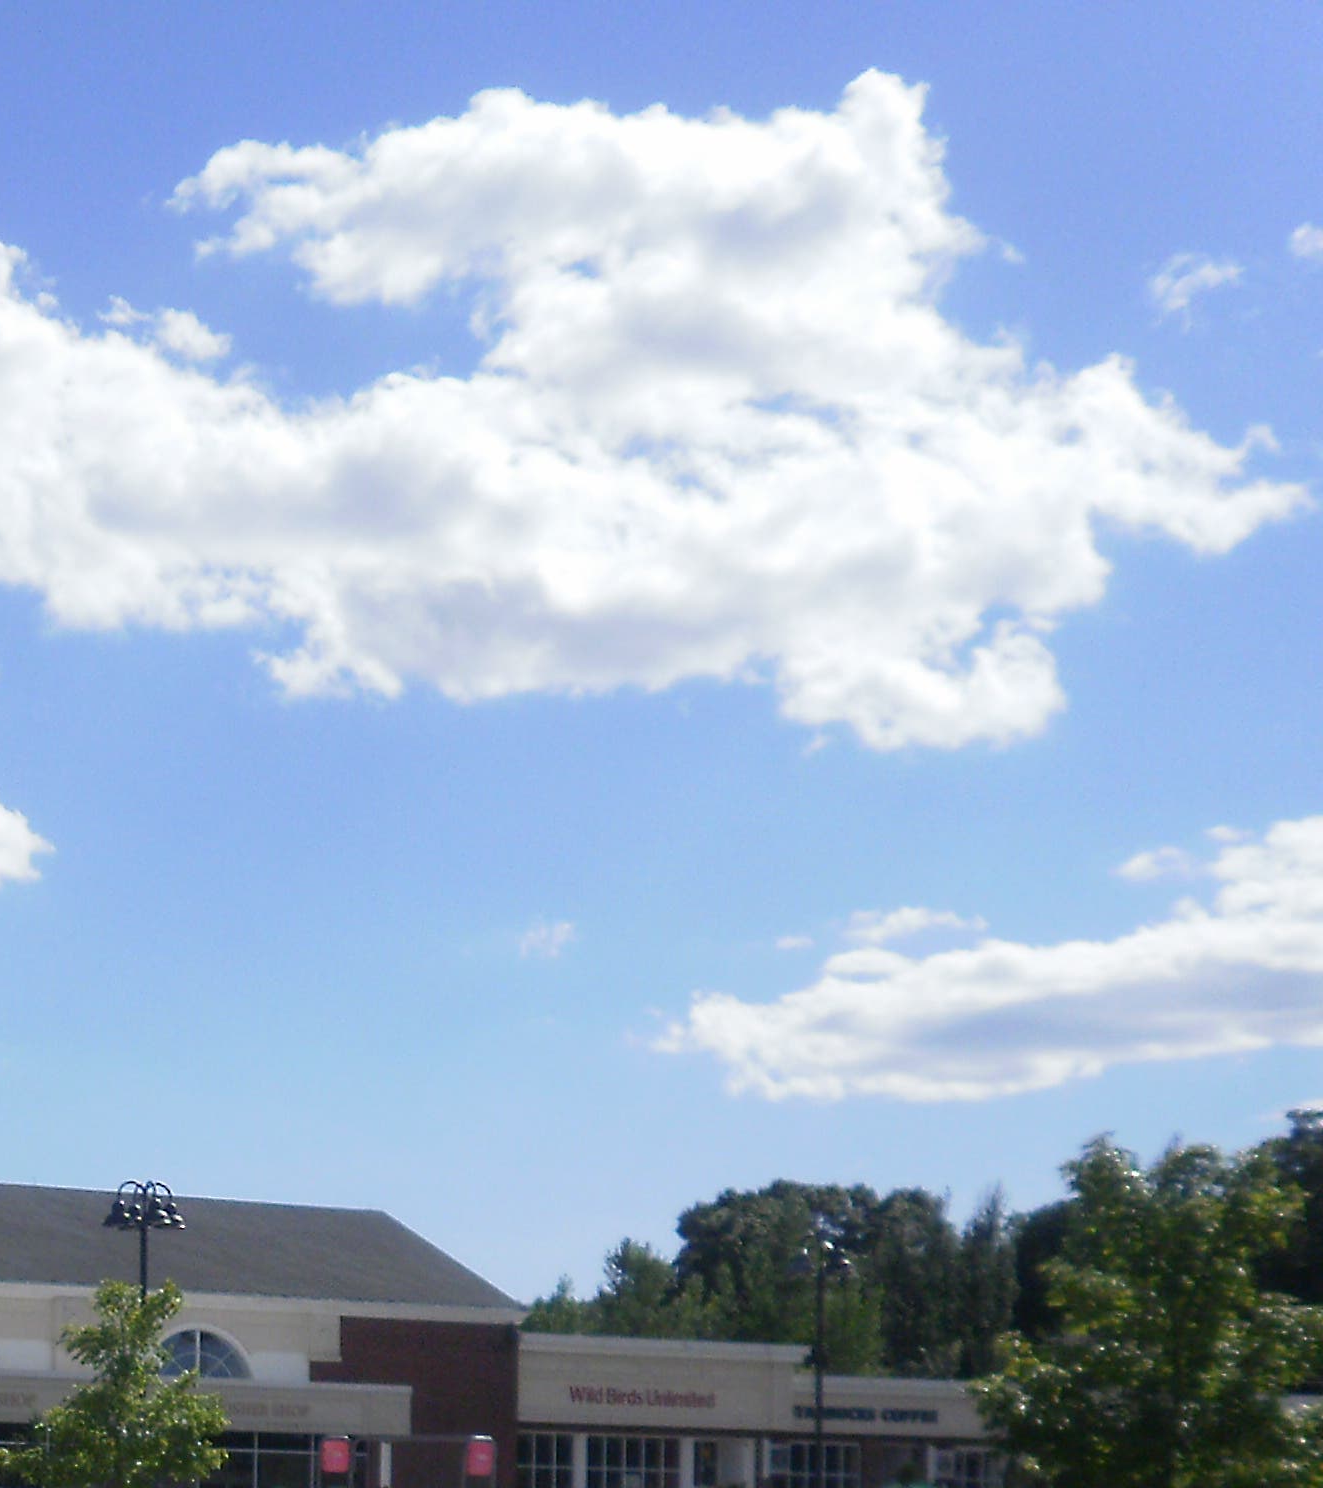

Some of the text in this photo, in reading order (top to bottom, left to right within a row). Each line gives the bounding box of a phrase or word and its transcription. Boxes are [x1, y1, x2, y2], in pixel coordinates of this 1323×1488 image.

[569, 1385, 717, 1409] Wild Birds Unlimited
